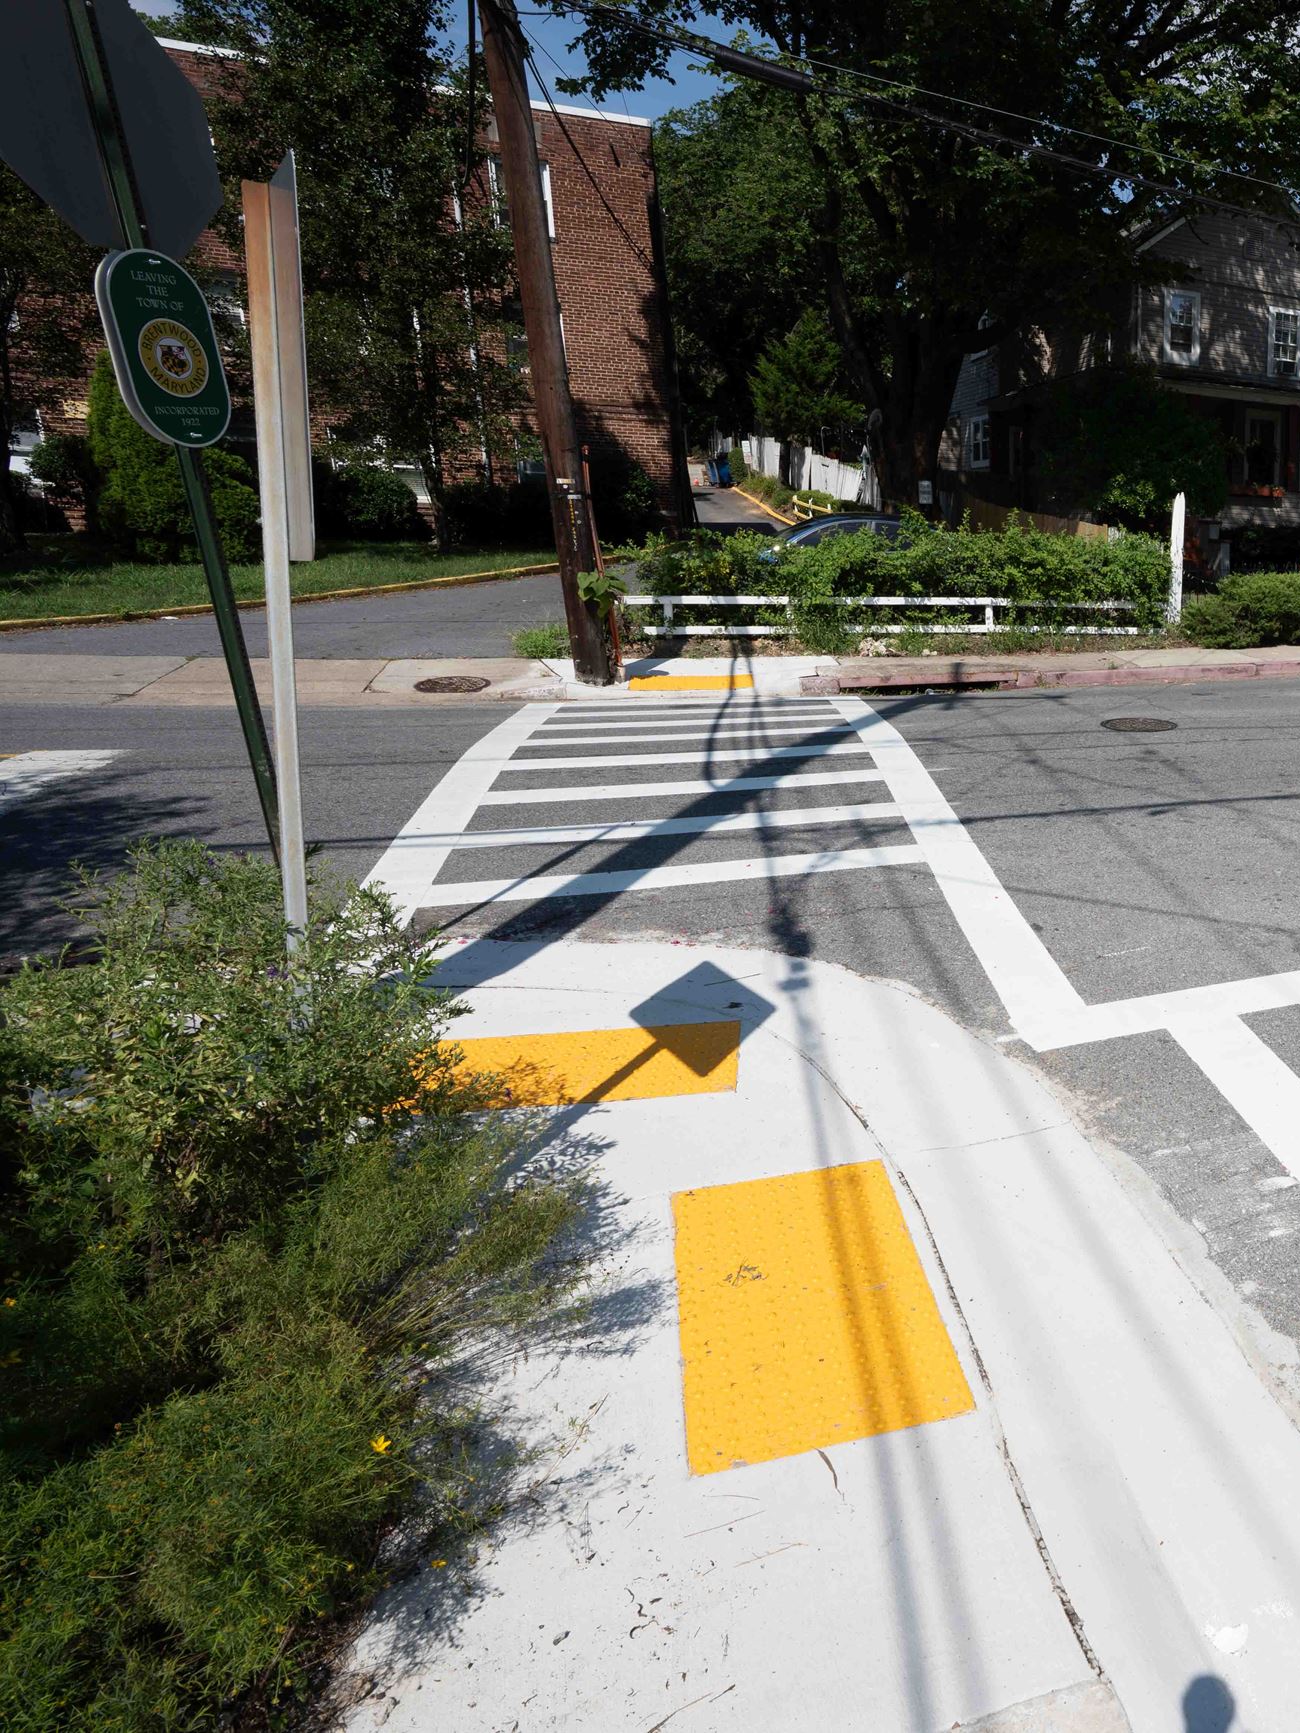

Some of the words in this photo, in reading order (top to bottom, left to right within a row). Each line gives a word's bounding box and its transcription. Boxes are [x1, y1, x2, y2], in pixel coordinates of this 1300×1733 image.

[130, 270, 176, 285] LEAVING
[146, 285, 169, 297] THE
[136, 297, 168, 309] TOWN
[170, 301, 184, 311] OF
[142, 322, 201, 357] BRENTWOOD
[151, 367, 206, 393] MARYLAND
[154, 406, 220, 416] INCORPORATED
[181, 418, 201, 426] 1922
